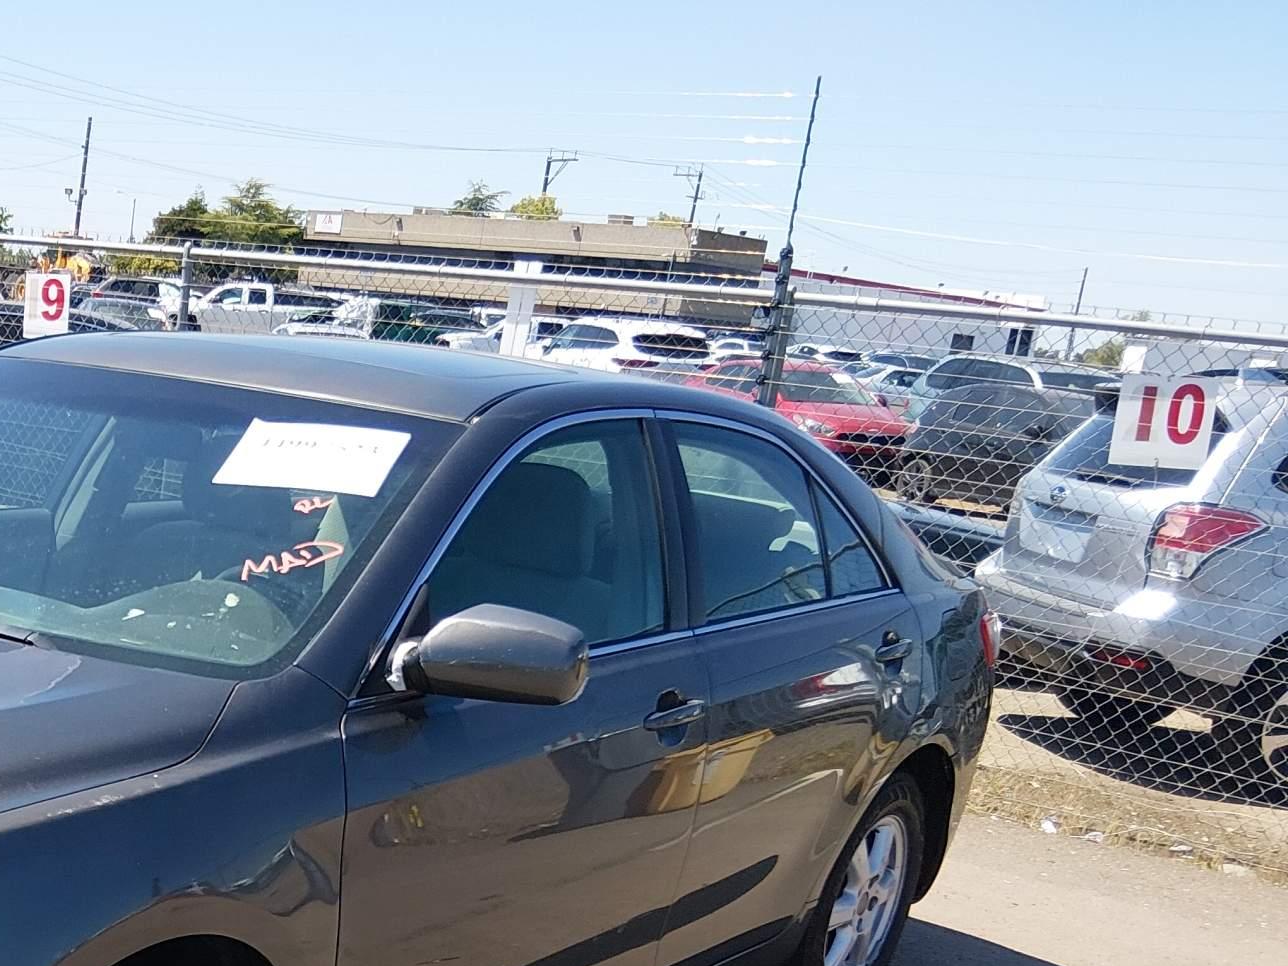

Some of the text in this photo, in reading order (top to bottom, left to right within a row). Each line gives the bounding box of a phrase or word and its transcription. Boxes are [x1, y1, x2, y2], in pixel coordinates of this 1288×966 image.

[41, 278, 65, 321] 9
[1135, 383, 1205, 445] 10
[240, 541, 344, 581] MAD
